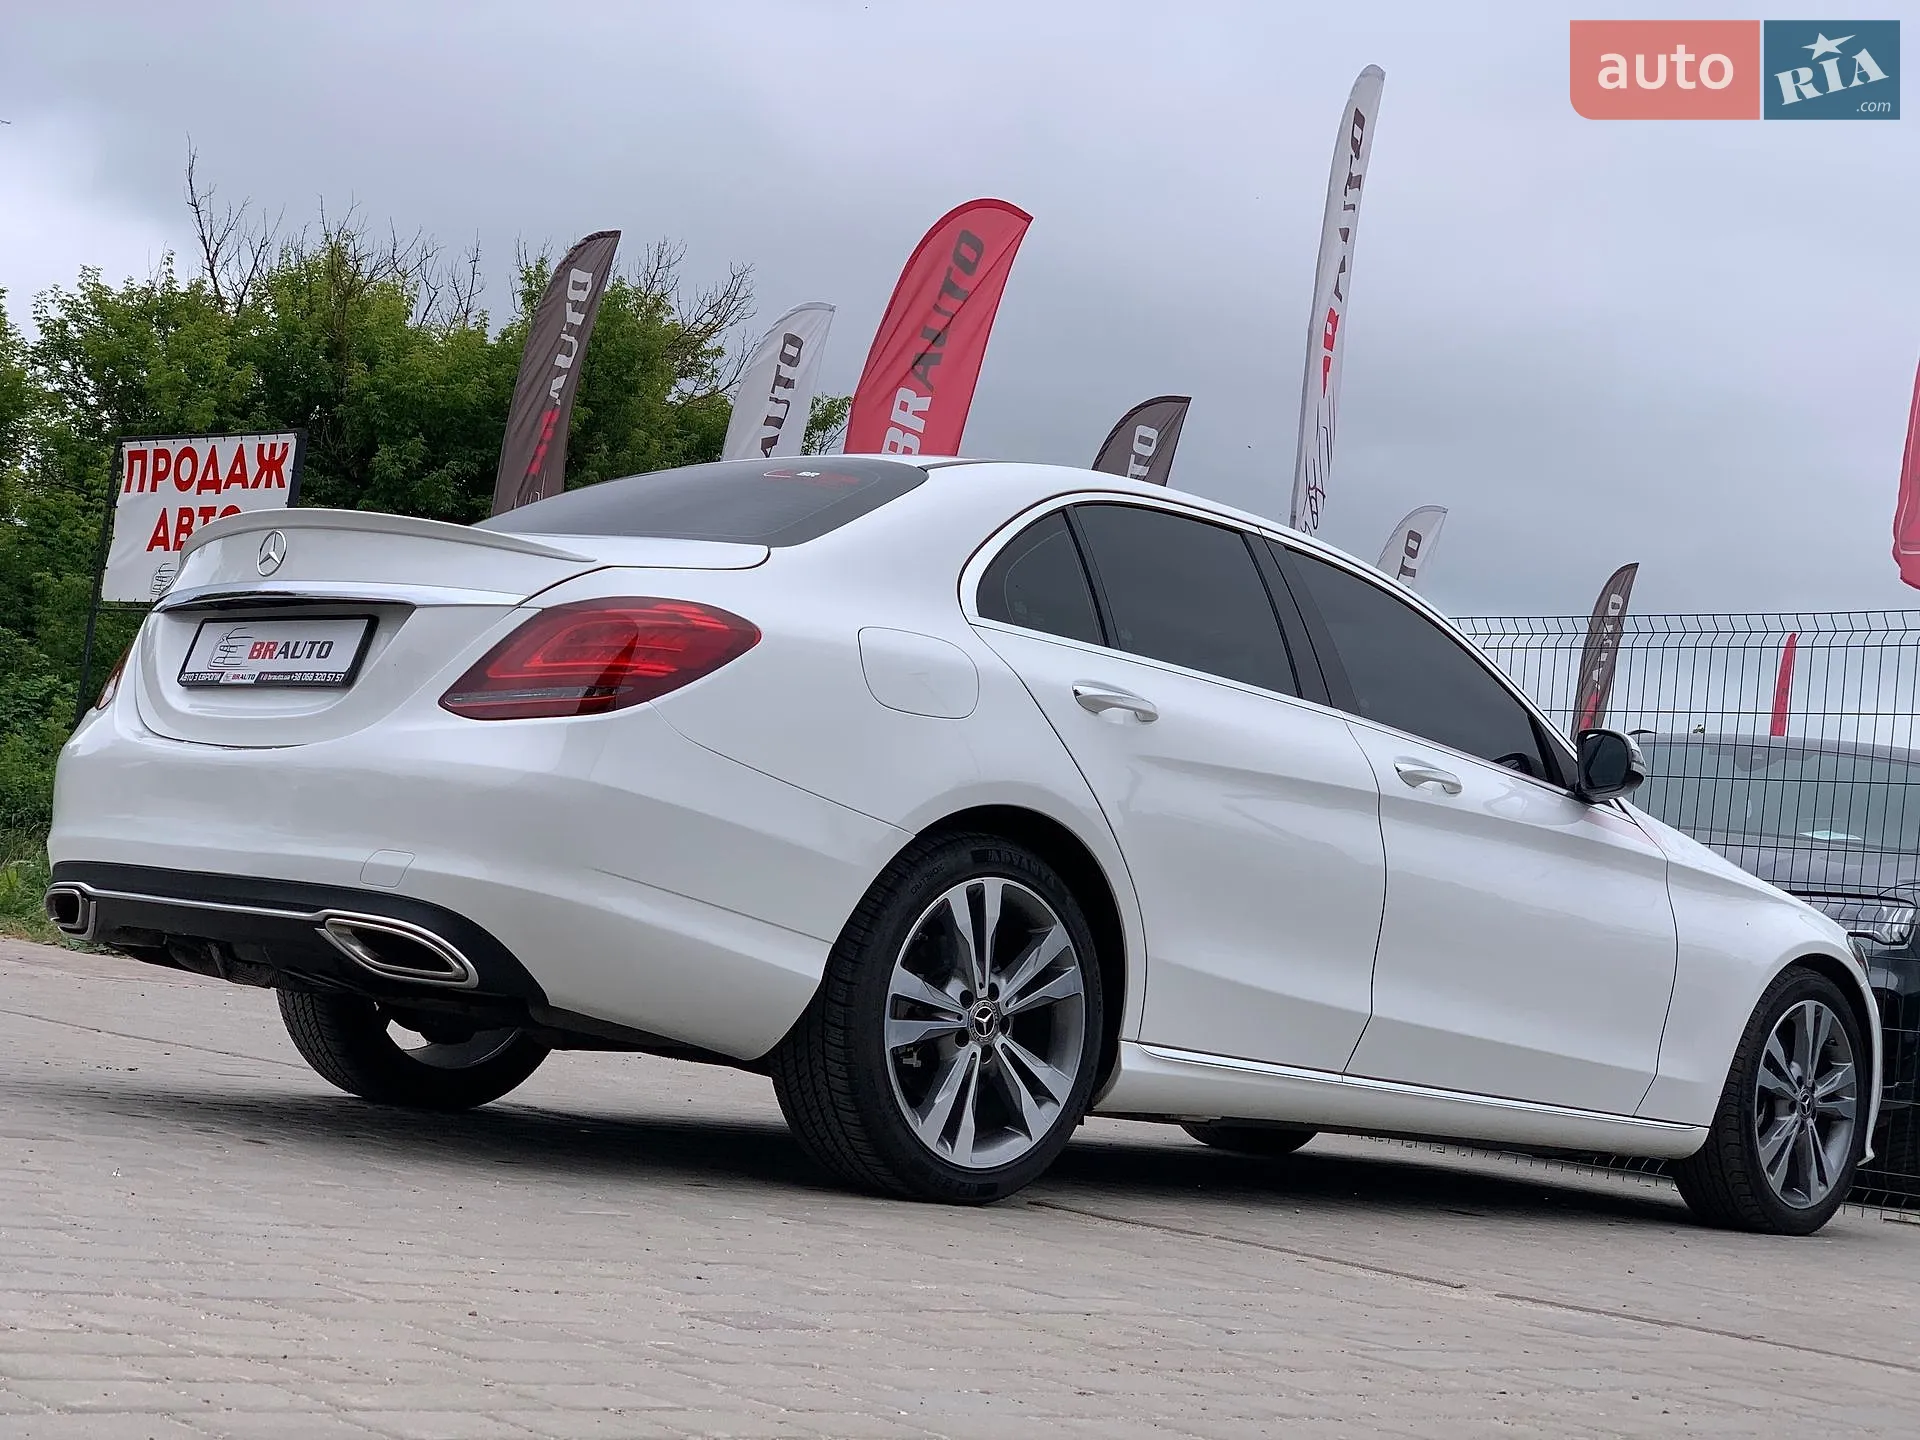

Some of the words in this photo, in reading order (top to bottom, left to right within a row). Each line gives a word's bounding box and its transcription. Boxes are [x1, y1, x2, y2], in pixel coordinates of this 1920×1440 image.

[881, 229, 985, 455] BRAUTO
[124, 443, 289, 495] ПРОДАЖ
[248, 640, 334, 660] BRAUTO
[326, 673, 336, 682] 57
[335, 673, 344, 682] 57
